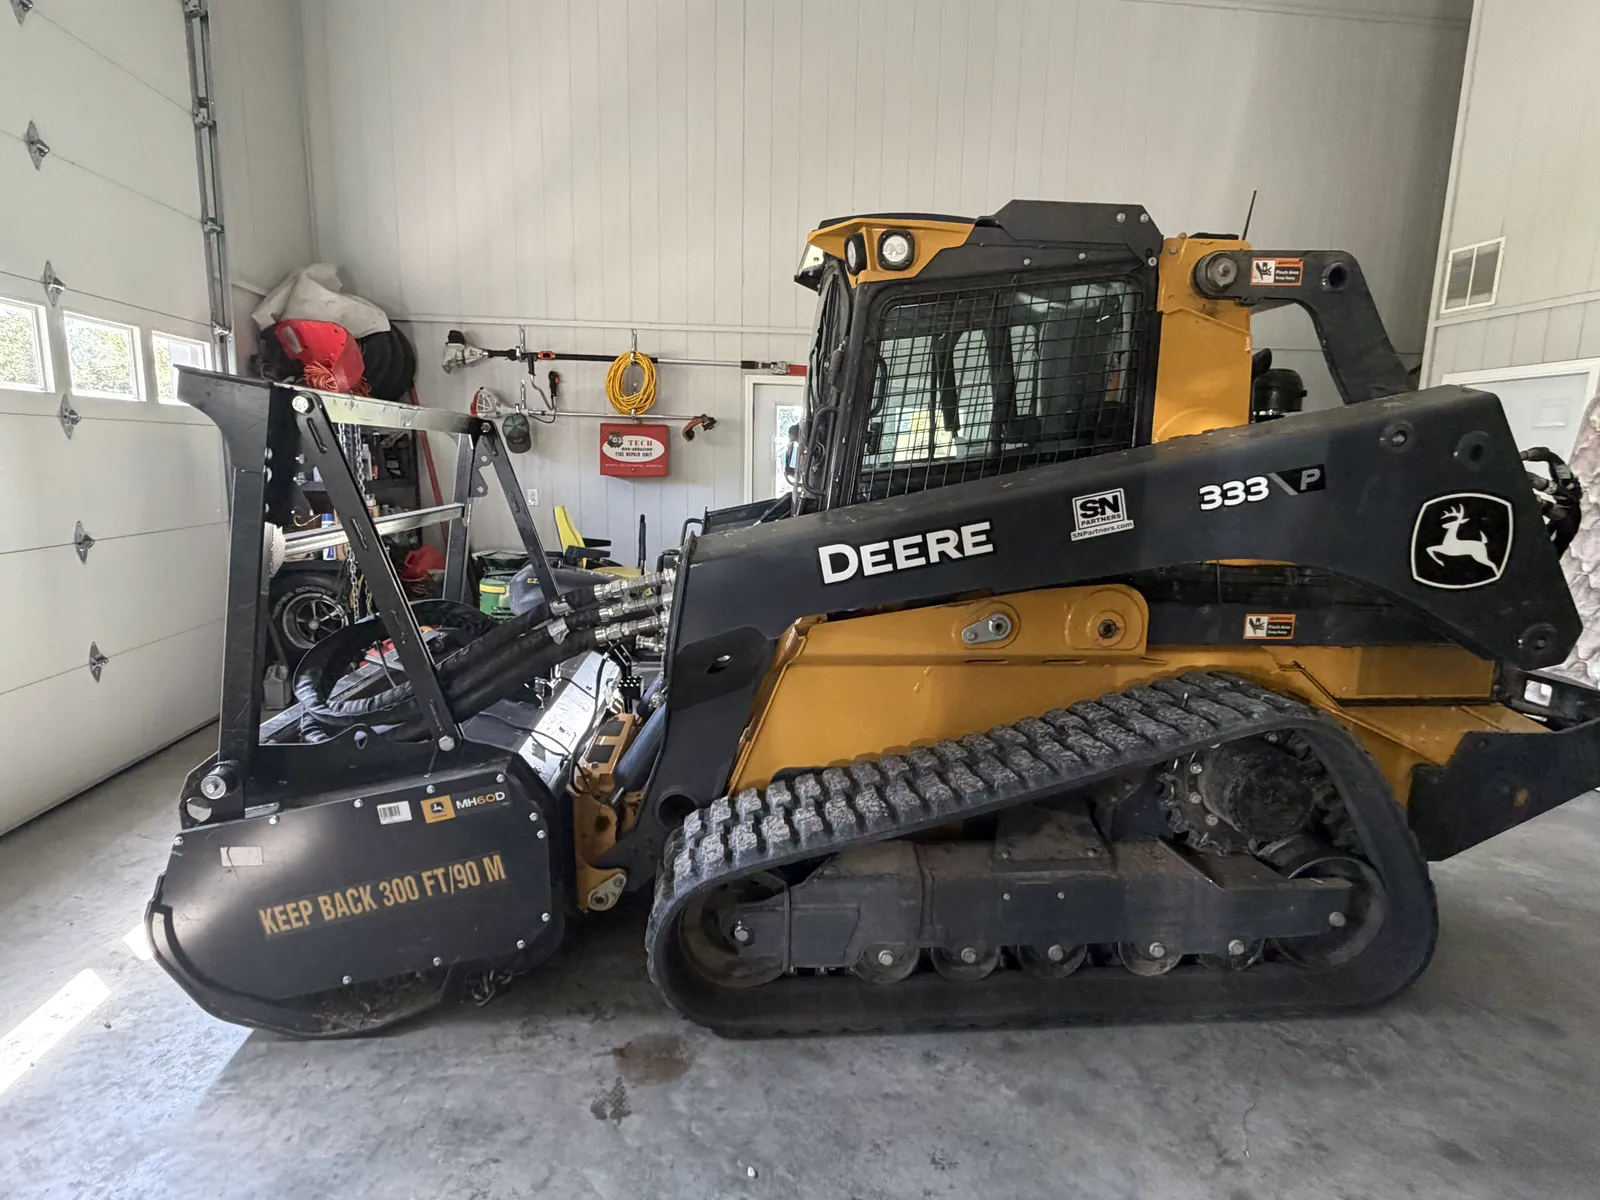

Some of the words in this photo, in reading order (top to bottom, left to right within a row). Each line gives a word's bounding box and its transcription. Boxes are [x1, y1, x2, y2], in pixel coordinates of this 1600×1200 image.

[1199, 476, 1270, 511] 333
[1079, 494, 1121, 519] SN
[1072, 522, 1133, 539] SNPartners.com
[1080, 513, 1122, 527] PARTNERS
[818, 521, 994, 585] DEERE
[455, 791, 506, 810] MH60D
[259, 899, 313, 935] KEEP
[318, 885, 378, 922] BACK
[379, 875, 420, 907] 300
[422, 861, 481, 895] FT/90
[482, 854, 507, 883] M
